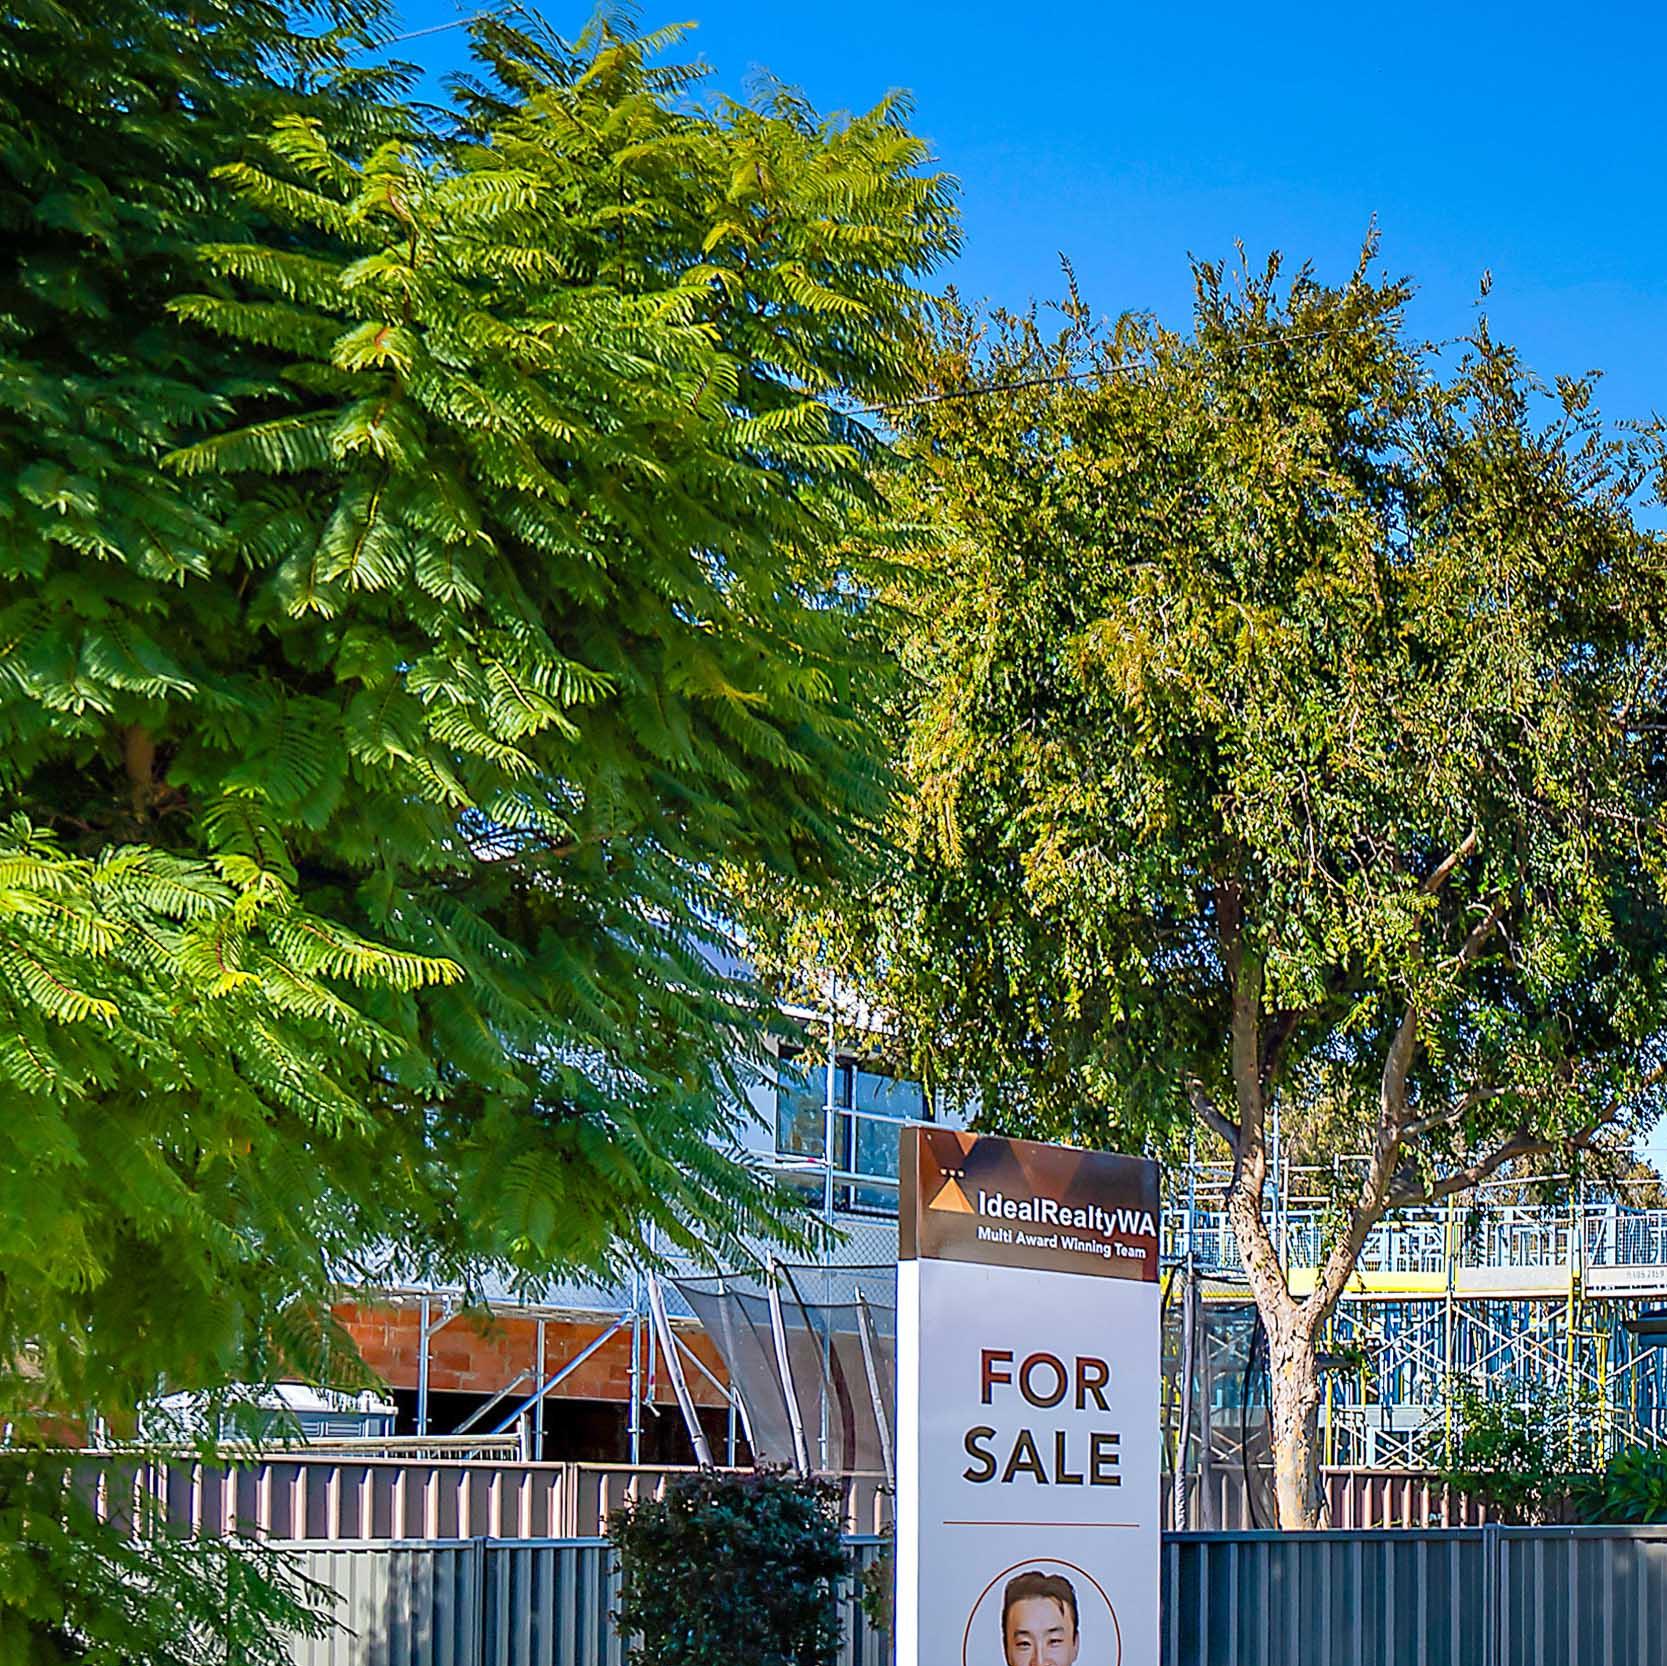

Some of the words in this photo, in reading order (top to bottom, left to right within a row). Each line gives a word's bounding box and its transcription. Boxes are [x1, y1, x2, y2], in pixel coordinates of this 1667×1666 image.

[978, 1190, 1157, 1237] IdealRealtyWA
[977, 1226, 1012, 1243] Multi
[1016, 1232, 1057, 1249] Award
[1060, 1235, 1111, 1258] Winning
[1114, 1243, 1146, 1259] Team
[981, 1348, 1112, 1412] FOR
[962, 1426, 1122, 1487] SALE
